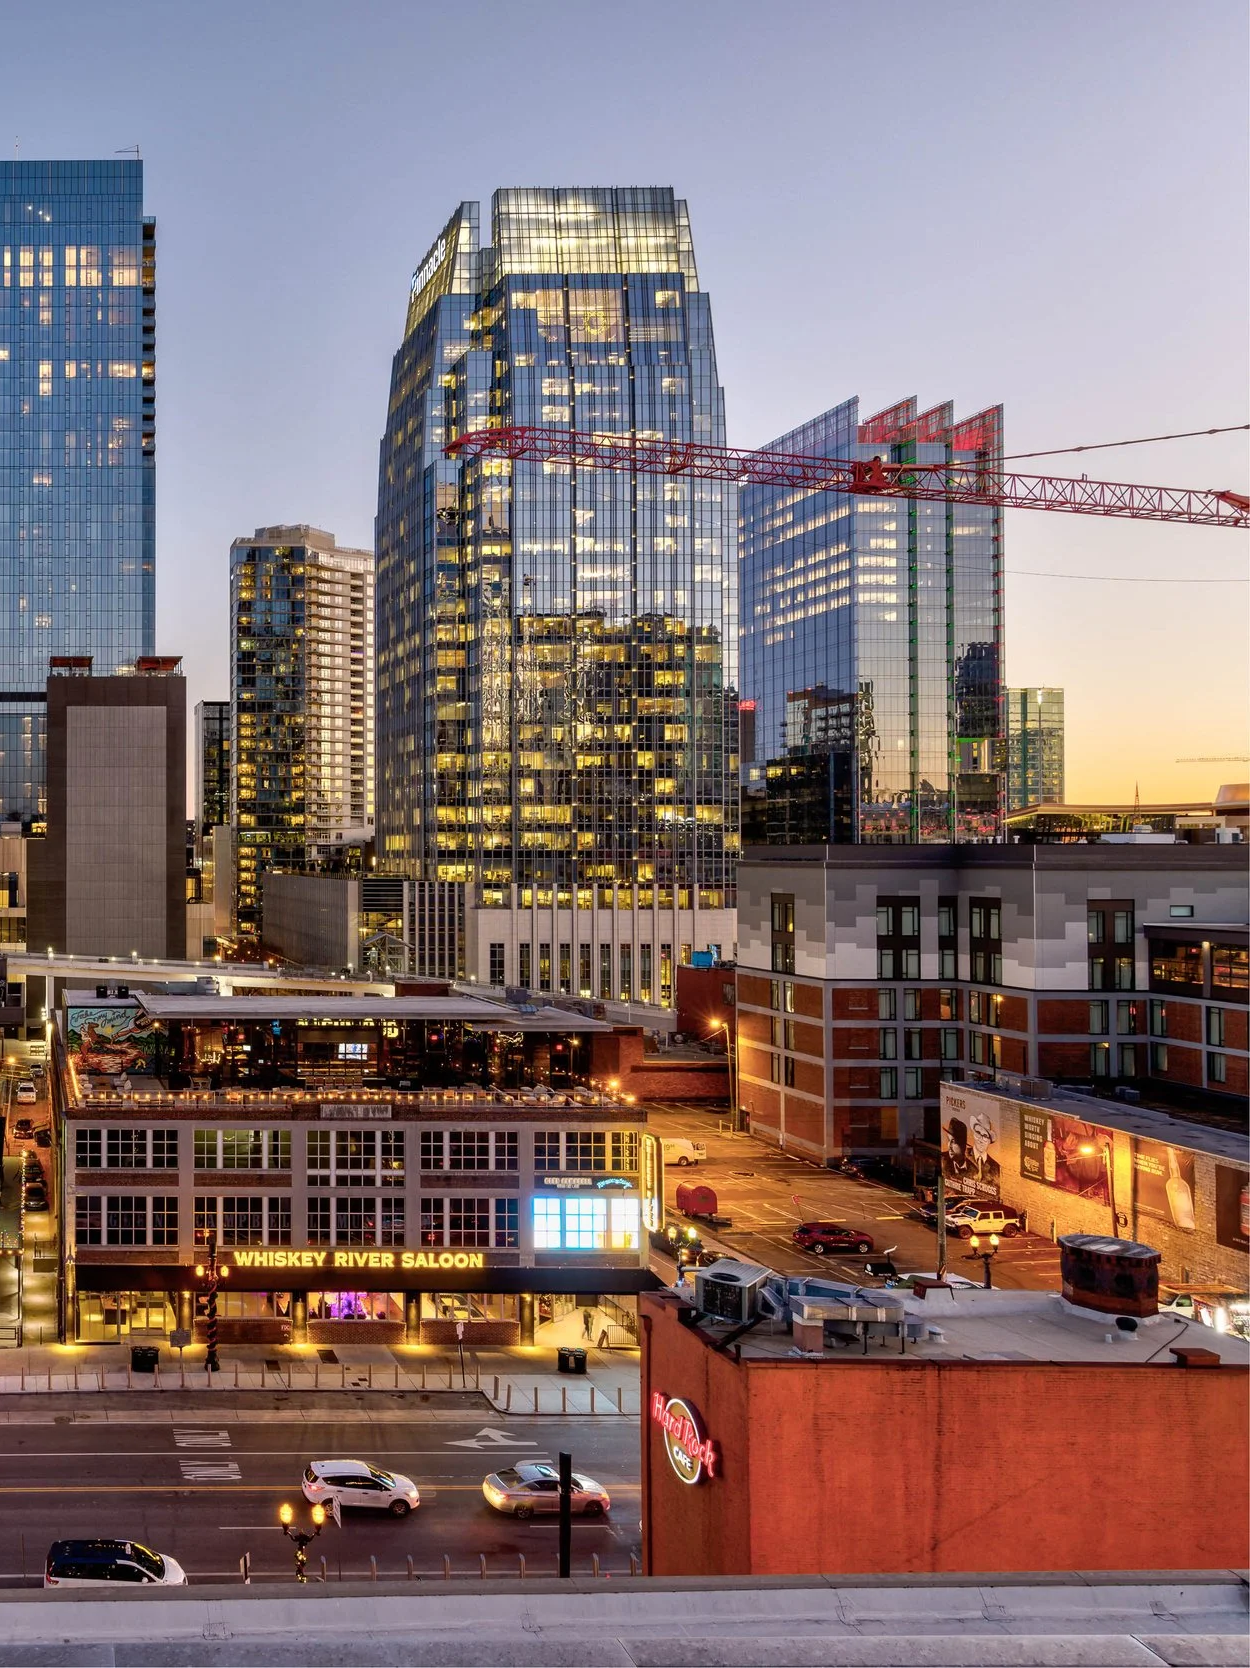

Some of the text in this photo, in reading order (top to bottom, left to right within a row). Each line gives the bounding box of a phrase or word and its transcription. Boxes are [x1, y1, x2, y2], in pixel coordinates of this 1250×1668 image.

[411, 238, 446, 303] Pinnacle
[946, 1096, 966, 1109] PICKERS
[1023, 1114, 1045, 1126] WHISKEY
[1024, 1123, 1040, 1133] WORTH
[1024, 1140, 1039, 1150] ABOUT
[963, 1177, 976, 1188] CHRIS
[108, 1213, 163, 1228] GLEN
[234, 1252, 484, 1268] WHISKEY RIVER SALOON
[173, 1428, 232, 1448] ONLY
[652, 1391, 717, 1478] Hard Rock
[673, 1446, 693, 1472] CAFE
[179, 1460, 243, 1480] ONLY
